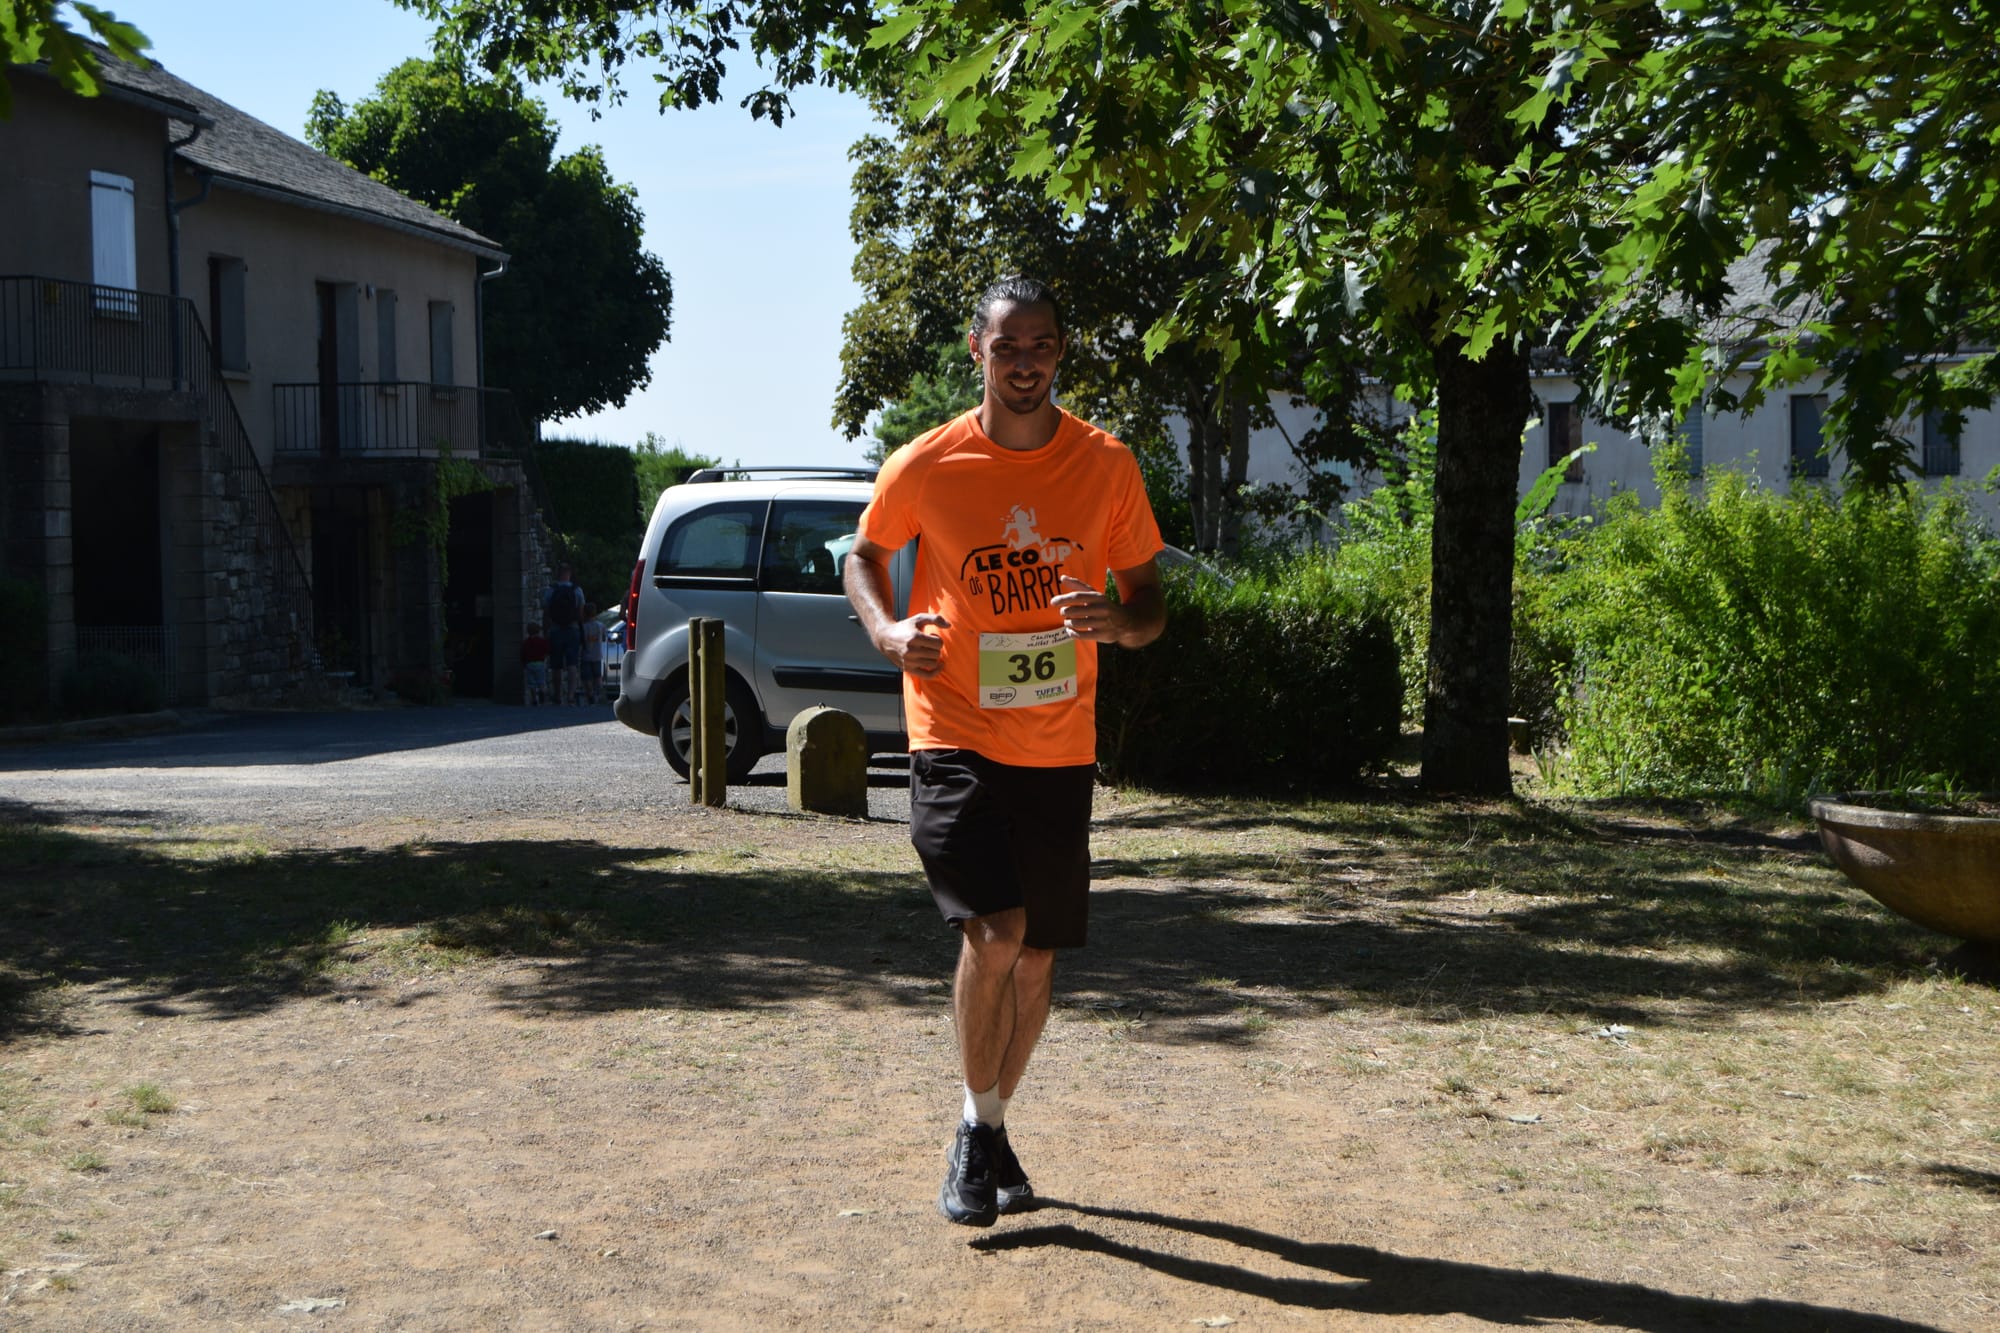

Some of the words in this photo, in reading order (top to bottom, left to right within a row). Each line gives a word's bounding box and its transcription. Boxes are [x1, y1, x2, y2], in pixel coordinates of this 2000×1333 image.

[975, 553, 1003, 572] LE
[969, 576, 983, 595] de
[1008, 651, 1056, 684] 36
